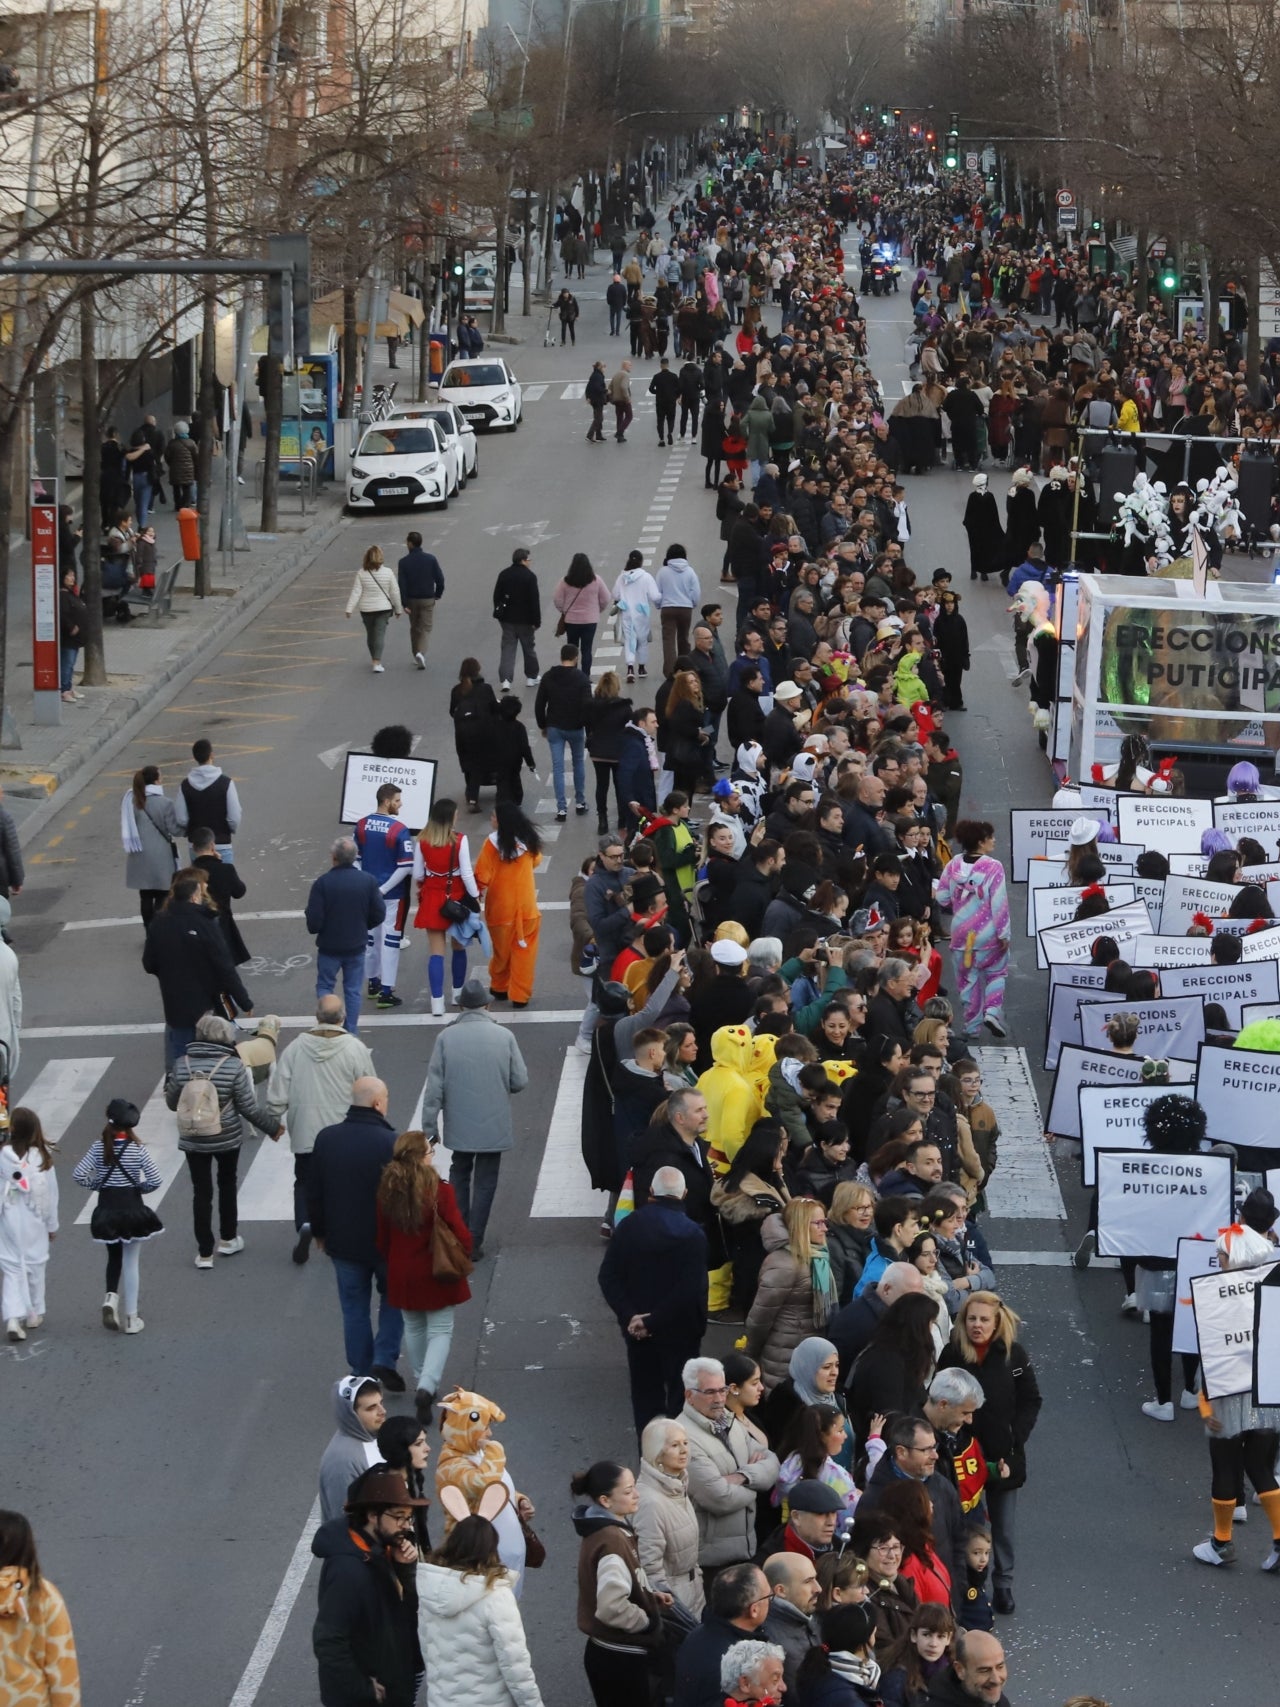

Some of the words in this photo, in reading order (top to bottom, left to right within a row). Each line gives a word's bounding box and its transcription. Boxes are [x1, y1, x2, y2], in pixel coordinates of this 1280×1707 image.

[362, 764, 416, 776] ERECCIONS
[362, 774, 418, 786] PUTICIPALS
[1135, 804, 1192, 814] ERECCIONS
[1222, 812, 1280, 820] ERECCIONS
[1030, 819, 1074, 828] ERECCIO
[1136, 818, 1196, 827] PUTICIPALS
[1031, 830, 1070, 839] PUTICIP
[1182, 888, 1236, 902] ERECCION
[1180, 902, 1228, 914] PUTICIPA
[1064, 918, 1126, 944] ERECCIONS
[1154, 946, 1211, 956] ERECCION
[1182, 973, 1252, 988] ERECCIONS
[1122, 1162, 1203, 1177] ERECCIONS
[1123, 1183, 1208, 1195] PUTICIPALS
[966, 1458, 978, 1475] R
